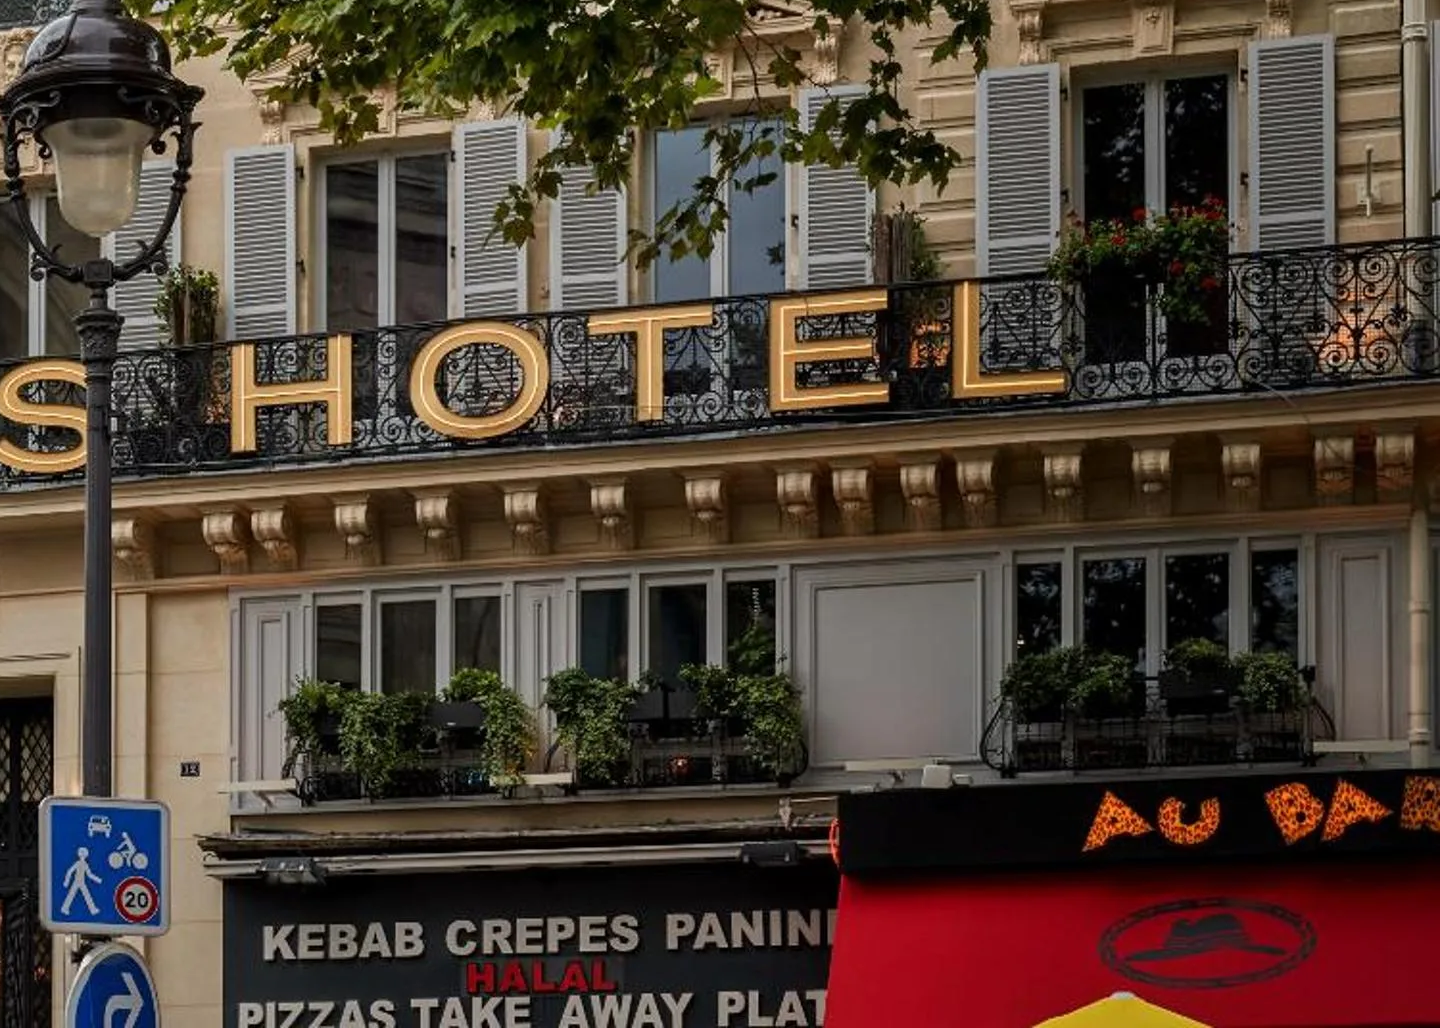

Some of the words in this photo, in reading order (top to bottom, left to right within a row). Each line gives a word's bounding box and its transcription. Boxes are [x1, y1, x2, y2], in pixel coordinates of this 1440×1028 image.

[231, 280, 1066, 453] HOTEL
[1081, 790, 1221, 853] AU
[125, 891, 149, 909] 20
[263, 921, 426, 961] KEBAB
[445, 914, 640, 956] CREPES
[465, 957, 620, 994] HALAL
[238, 998, 397, 1028] PIZZAS
[410, 995, 532, 1028] TAKE
[558, 992, 694, 1028] AWAY
